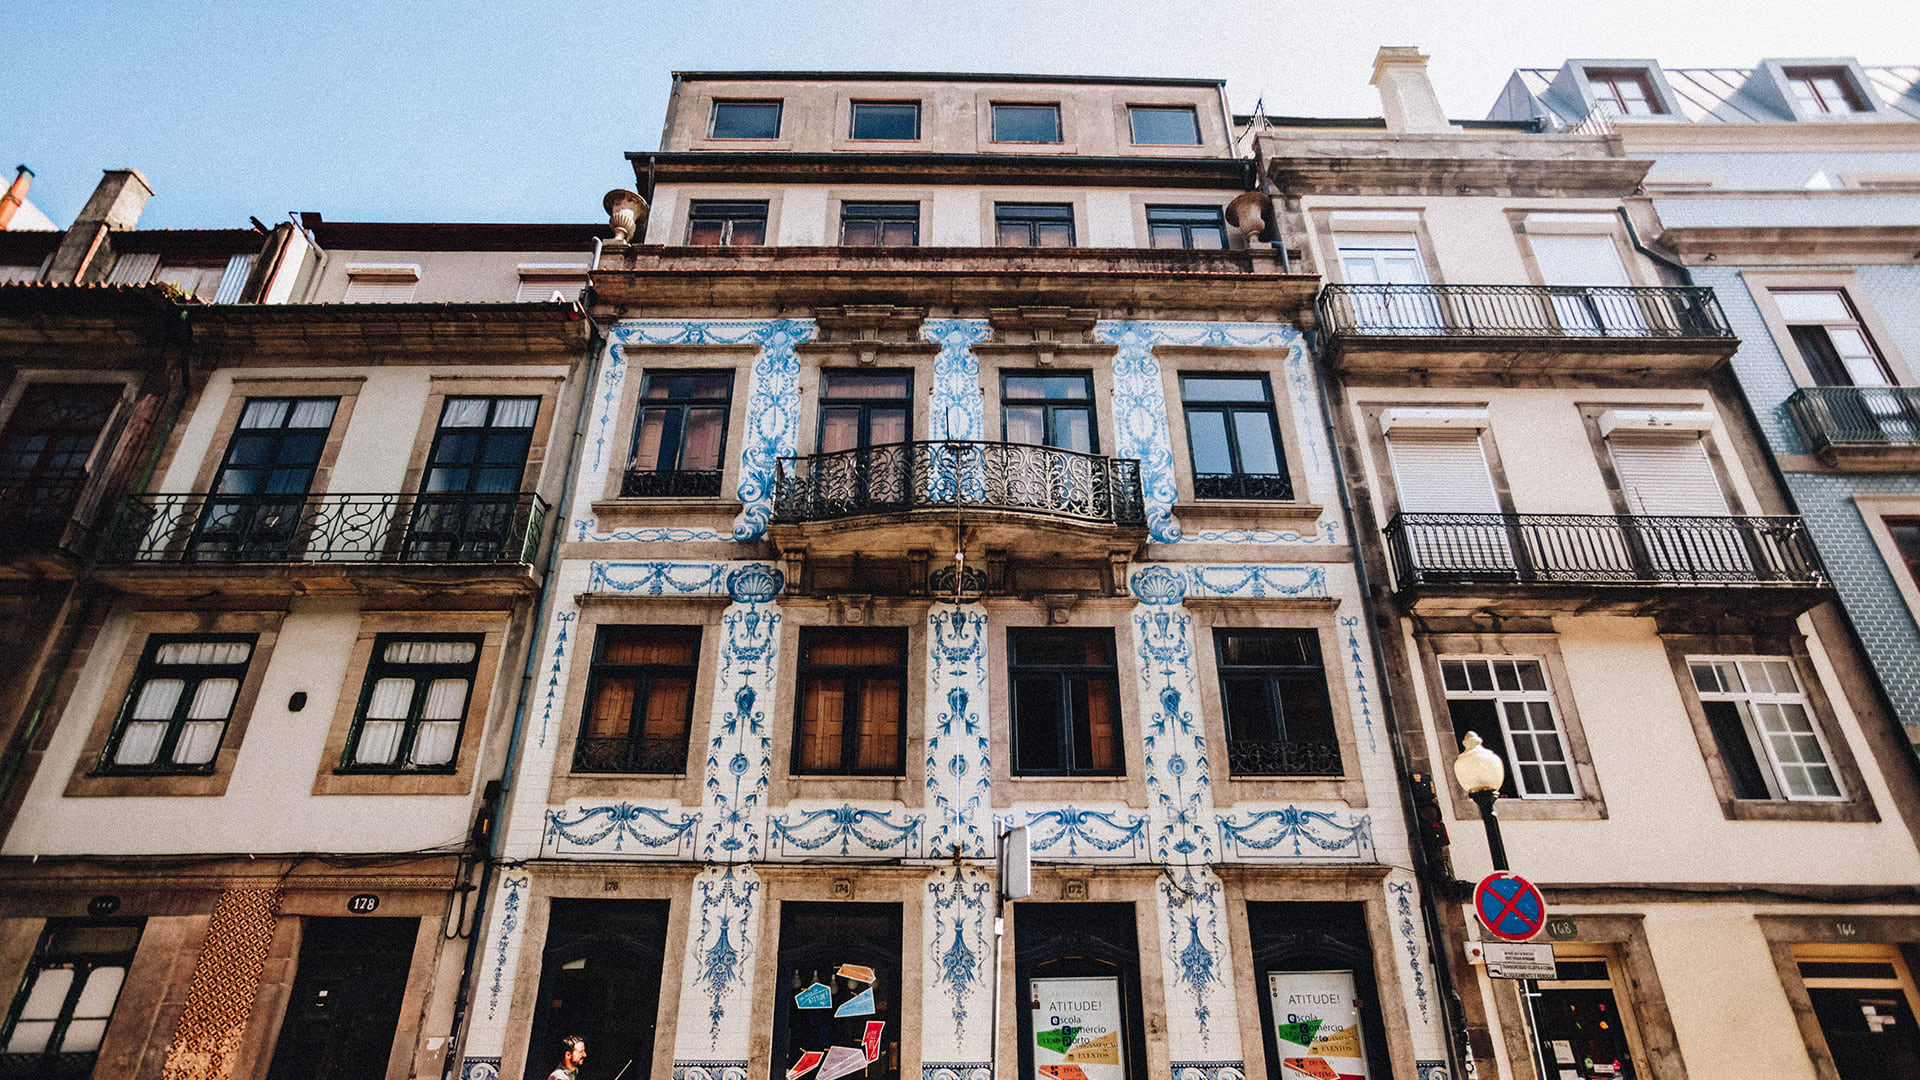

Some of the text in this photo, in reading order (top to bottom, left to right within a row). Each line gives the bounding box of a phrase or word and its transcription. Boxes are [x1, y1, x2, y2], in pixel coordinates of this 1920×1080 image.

[835, 884, 849, 893] 174
[1068, 884, 1082, 894] 172
[354, 898, 375, 910] 178
[1551, 922, 1572, 935] 168
[1836, 923, 1855, 936] 166
[1288, 994, 1341, 1004] ATITUDE!
[1049, 1001, 1102, 1011] ATITUDE!
